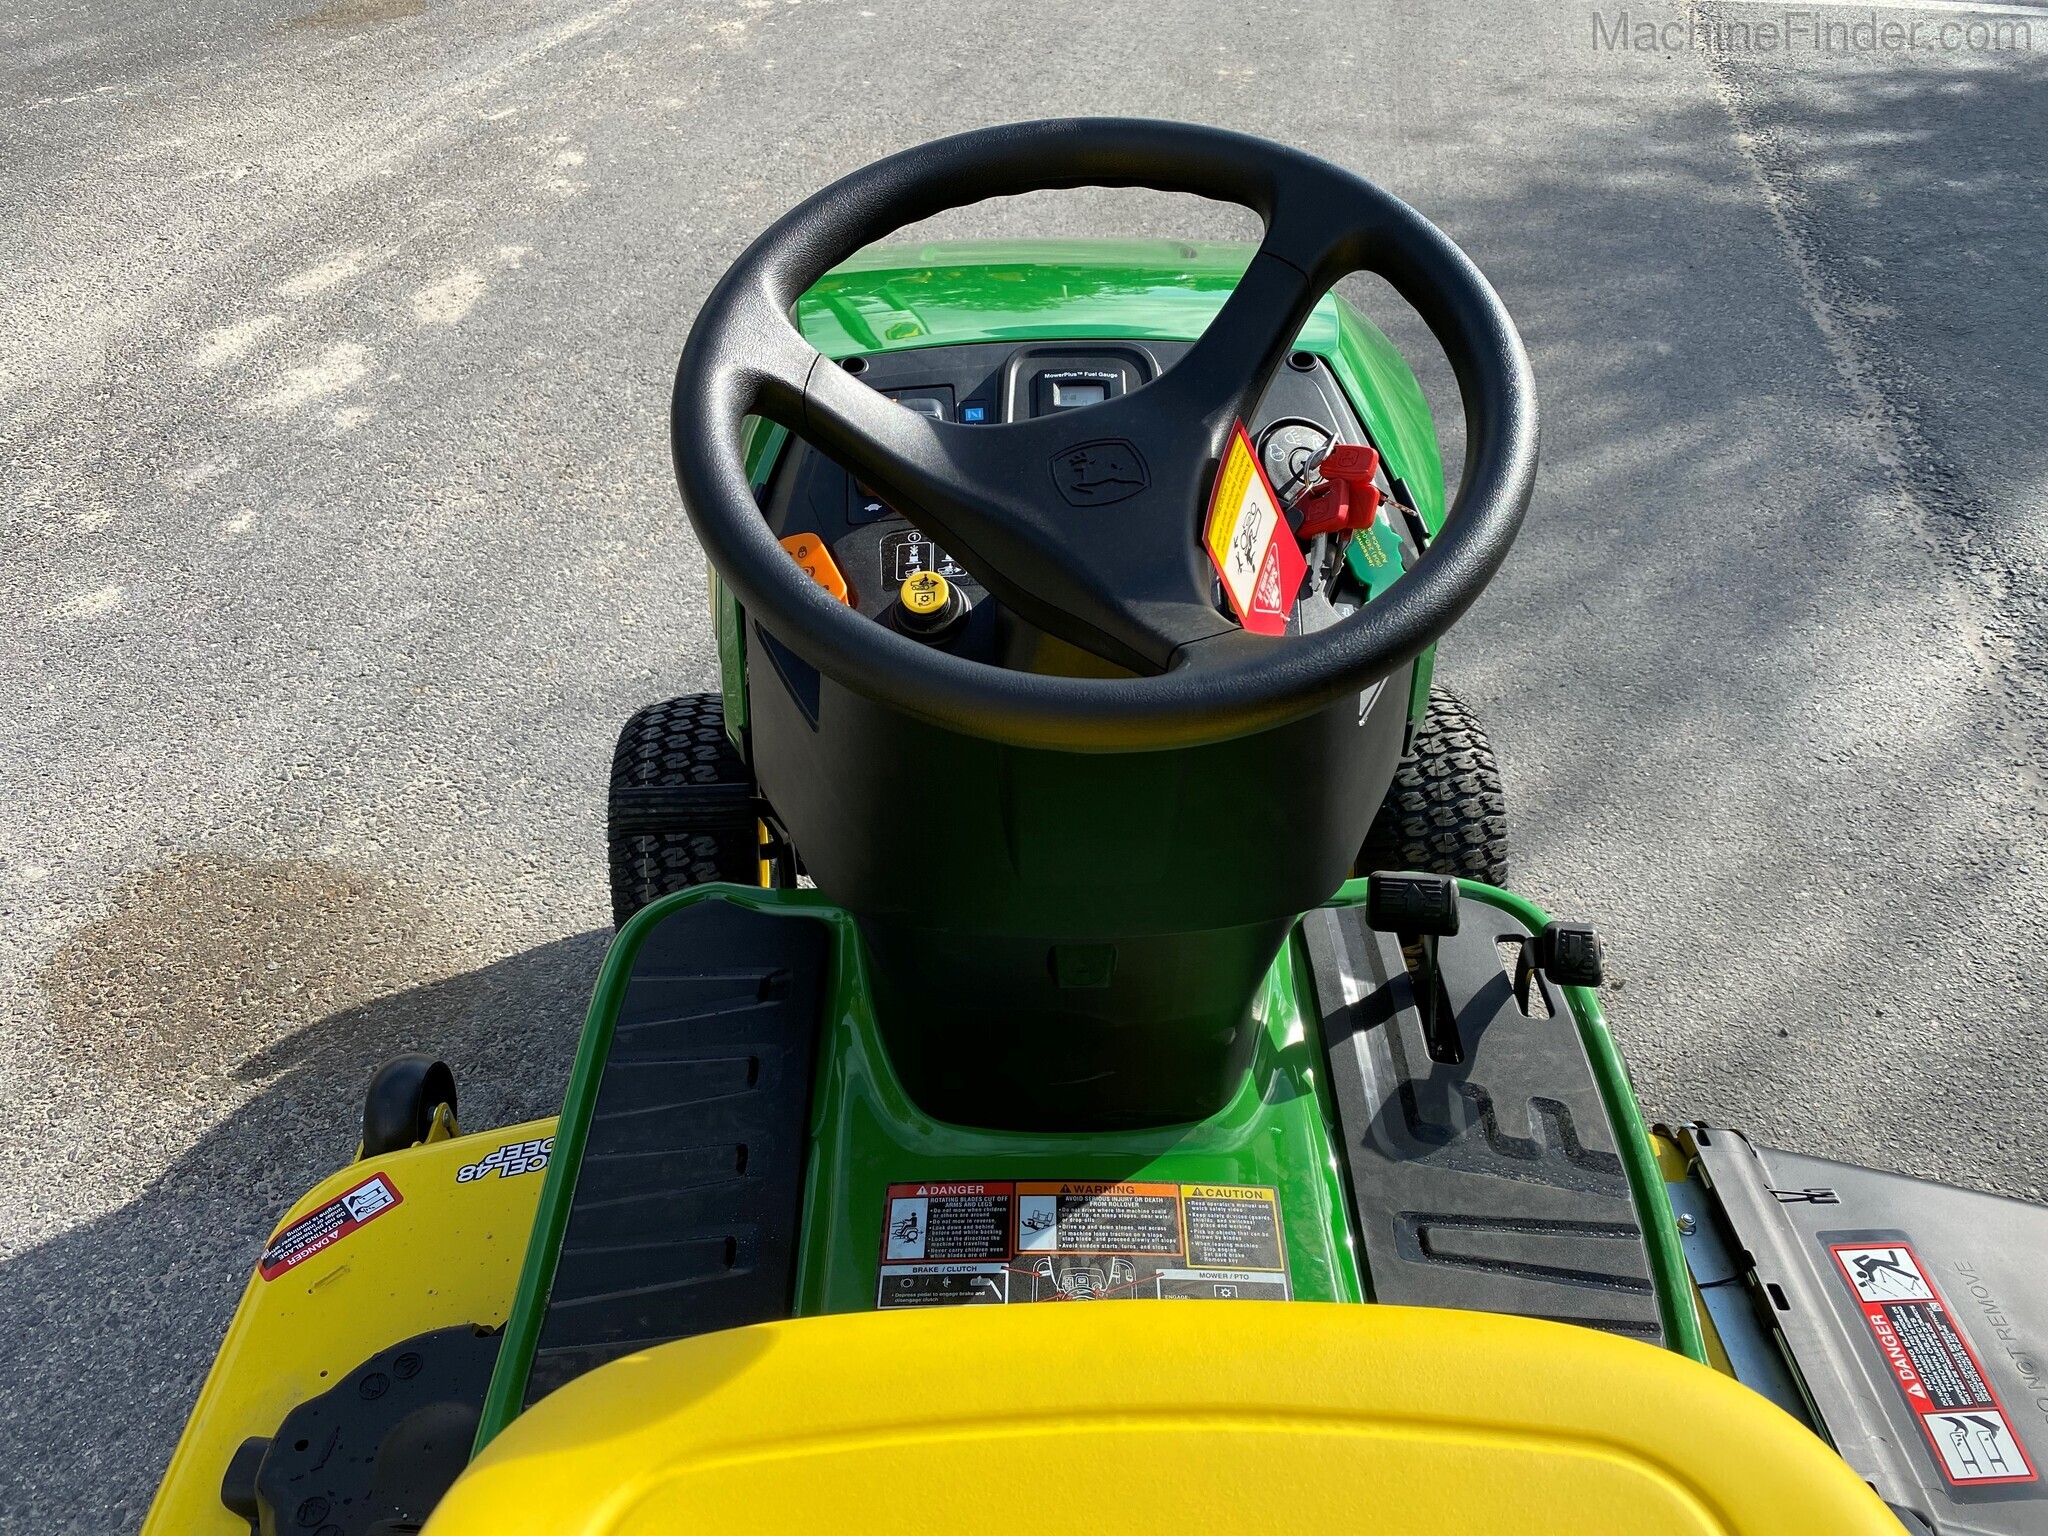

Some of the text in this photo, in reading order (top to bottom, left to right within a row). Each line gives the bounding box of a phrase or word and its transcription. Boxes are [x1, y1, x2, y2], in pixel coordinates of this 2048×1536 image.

[1098, 371, 1118, 379] Gauge
[1360, 530, 1374, 551] 240-04
[1367, 527, 1388, 563] AgProCo.co
[931, 1186, 984, 1194] DANGER
[1074, 1185, 1135, 1195] WARNING
[1206, 1189, 1263, 1199] CAUTION
[324, 1216, 335, 1226] not
[335, 1210, 346, 1219] Do
[292, 1228, 313, 1246] hands
[312, 1222, 324, 1233] put
[277, 1216, 344, 1261] ROTATING BLADE
[271, 1247, 284, 1258] feet
[286, 1236, 330, 1266] DANGER
[1953, 1259, 2018, 1341] REMOVE
[1869, 1314, 1916, 1379] DANGER
[1892, 1320, 1933, 1390] ROTATING BLADE
[1909, 1317, 1954, 1391] THROWN OBJECTS
[2006, 1346, 2046, 1390] NOT
